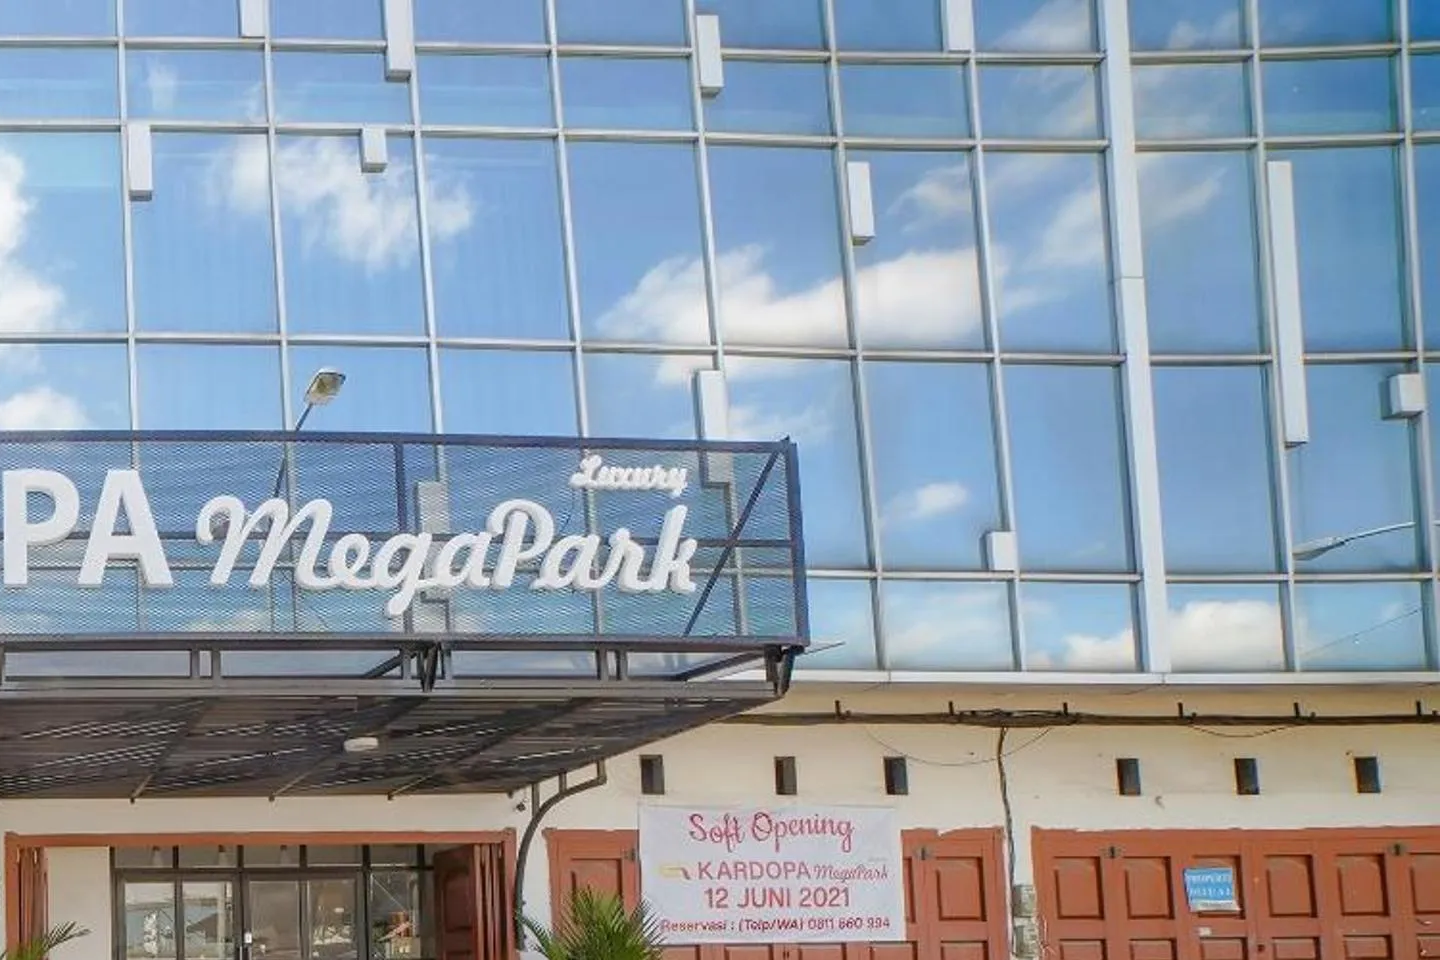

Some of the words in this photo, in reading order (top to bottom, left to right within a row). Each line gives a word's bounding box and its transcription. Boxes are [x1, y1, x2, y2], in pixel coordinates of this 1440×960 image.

[570, 454, 688, 497] Luxury
[195, 496, 697, 617] MegaPark
[688, 813, 744, 852] Soft
[751, 811, 856, 852] Opening
[697, 860, 811, 881] KARDOPA
[704, 889, 729, 909] 12
[737, 888, 791, 908] JUNI
[799, 886, 850, 907] 2021
[661, 919, 726, 933] Reservasi
